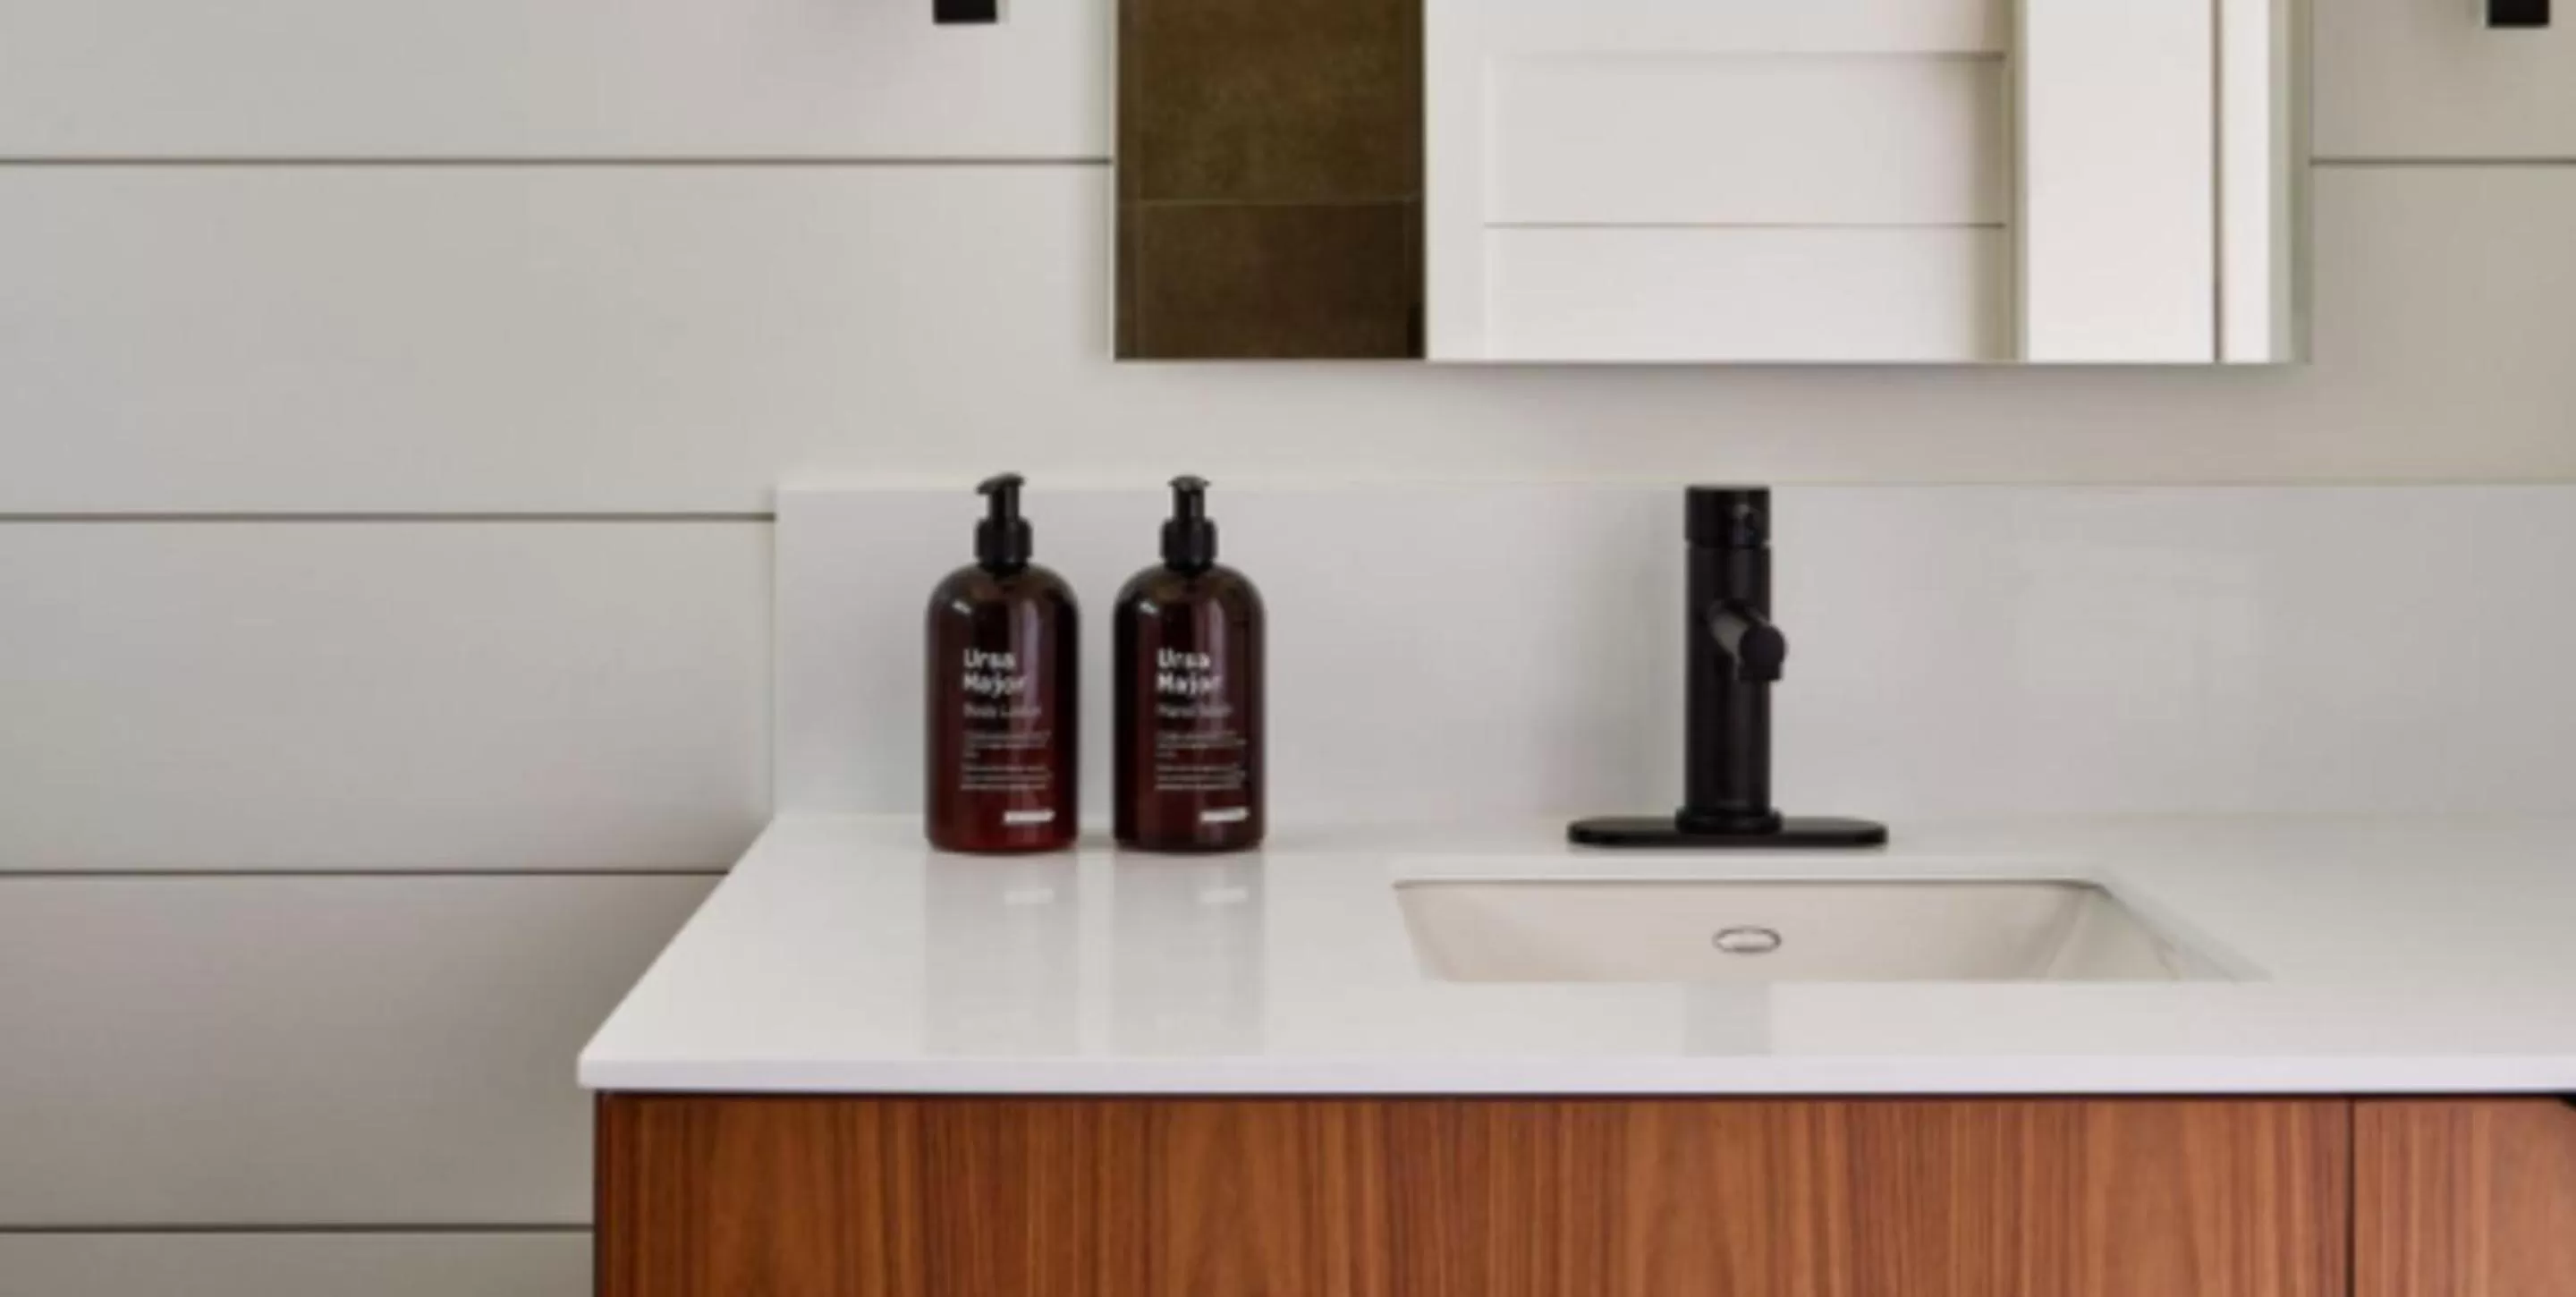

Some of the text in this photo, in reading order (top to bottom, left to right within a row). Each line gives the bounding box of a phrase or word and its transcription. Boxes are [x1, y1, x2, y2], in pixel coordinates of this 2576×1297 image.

[963, 648, 1016, 669] Ursa
[1157, 647, 1211, 669] Ursa
[963, 672, 1028, 698] Major
[1157, 672, 1223, 697] Major
